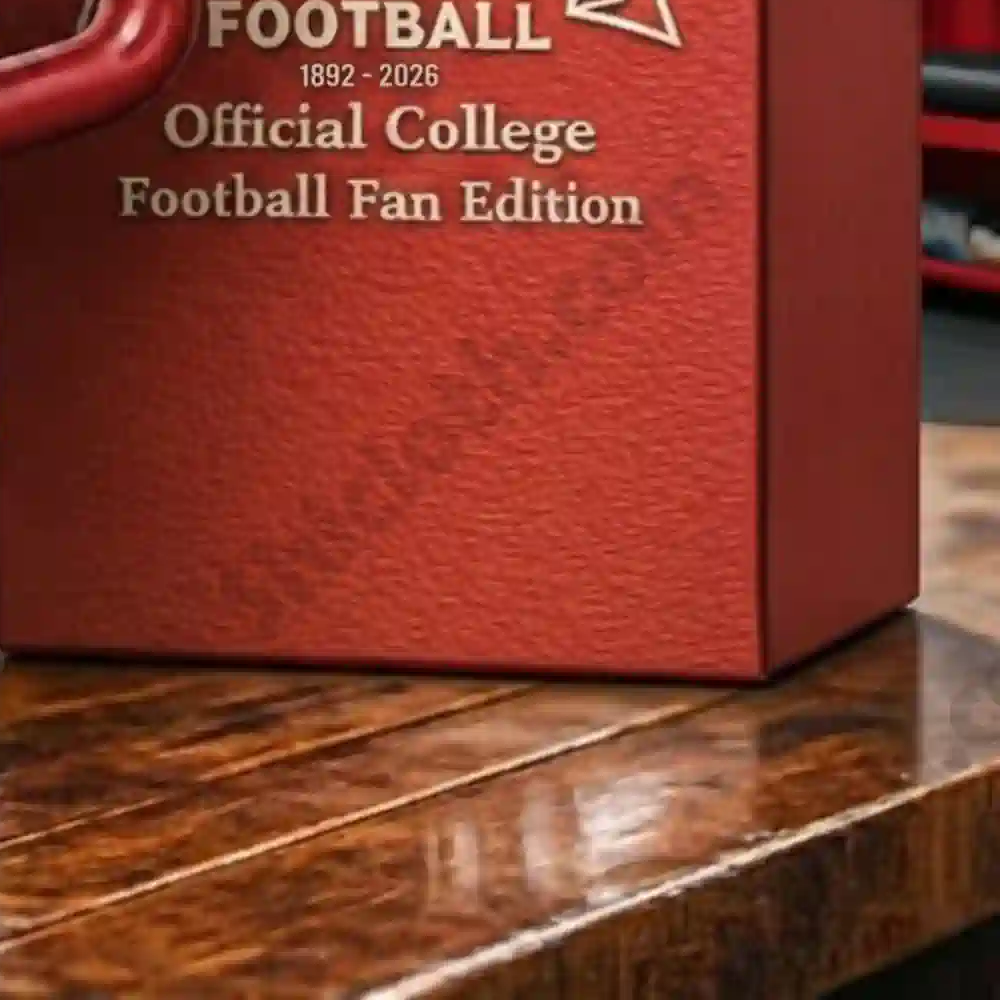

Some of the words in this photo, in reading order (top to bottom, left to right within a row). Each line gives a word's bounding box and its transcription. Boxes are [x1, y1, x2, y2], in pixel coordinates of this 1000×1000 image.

[206, 0, 552, 51] FOOTBALL
[299, 63, 355, 88] 1892
[379, 63, 440, 88] 2026
[164, 103, 366, 151] Official
[385, 104, 597, 165] College
[119, 174, 331, 220] Football
[349, 178, 442, 222] Fan
[461, 181, 642, 227] Edition
